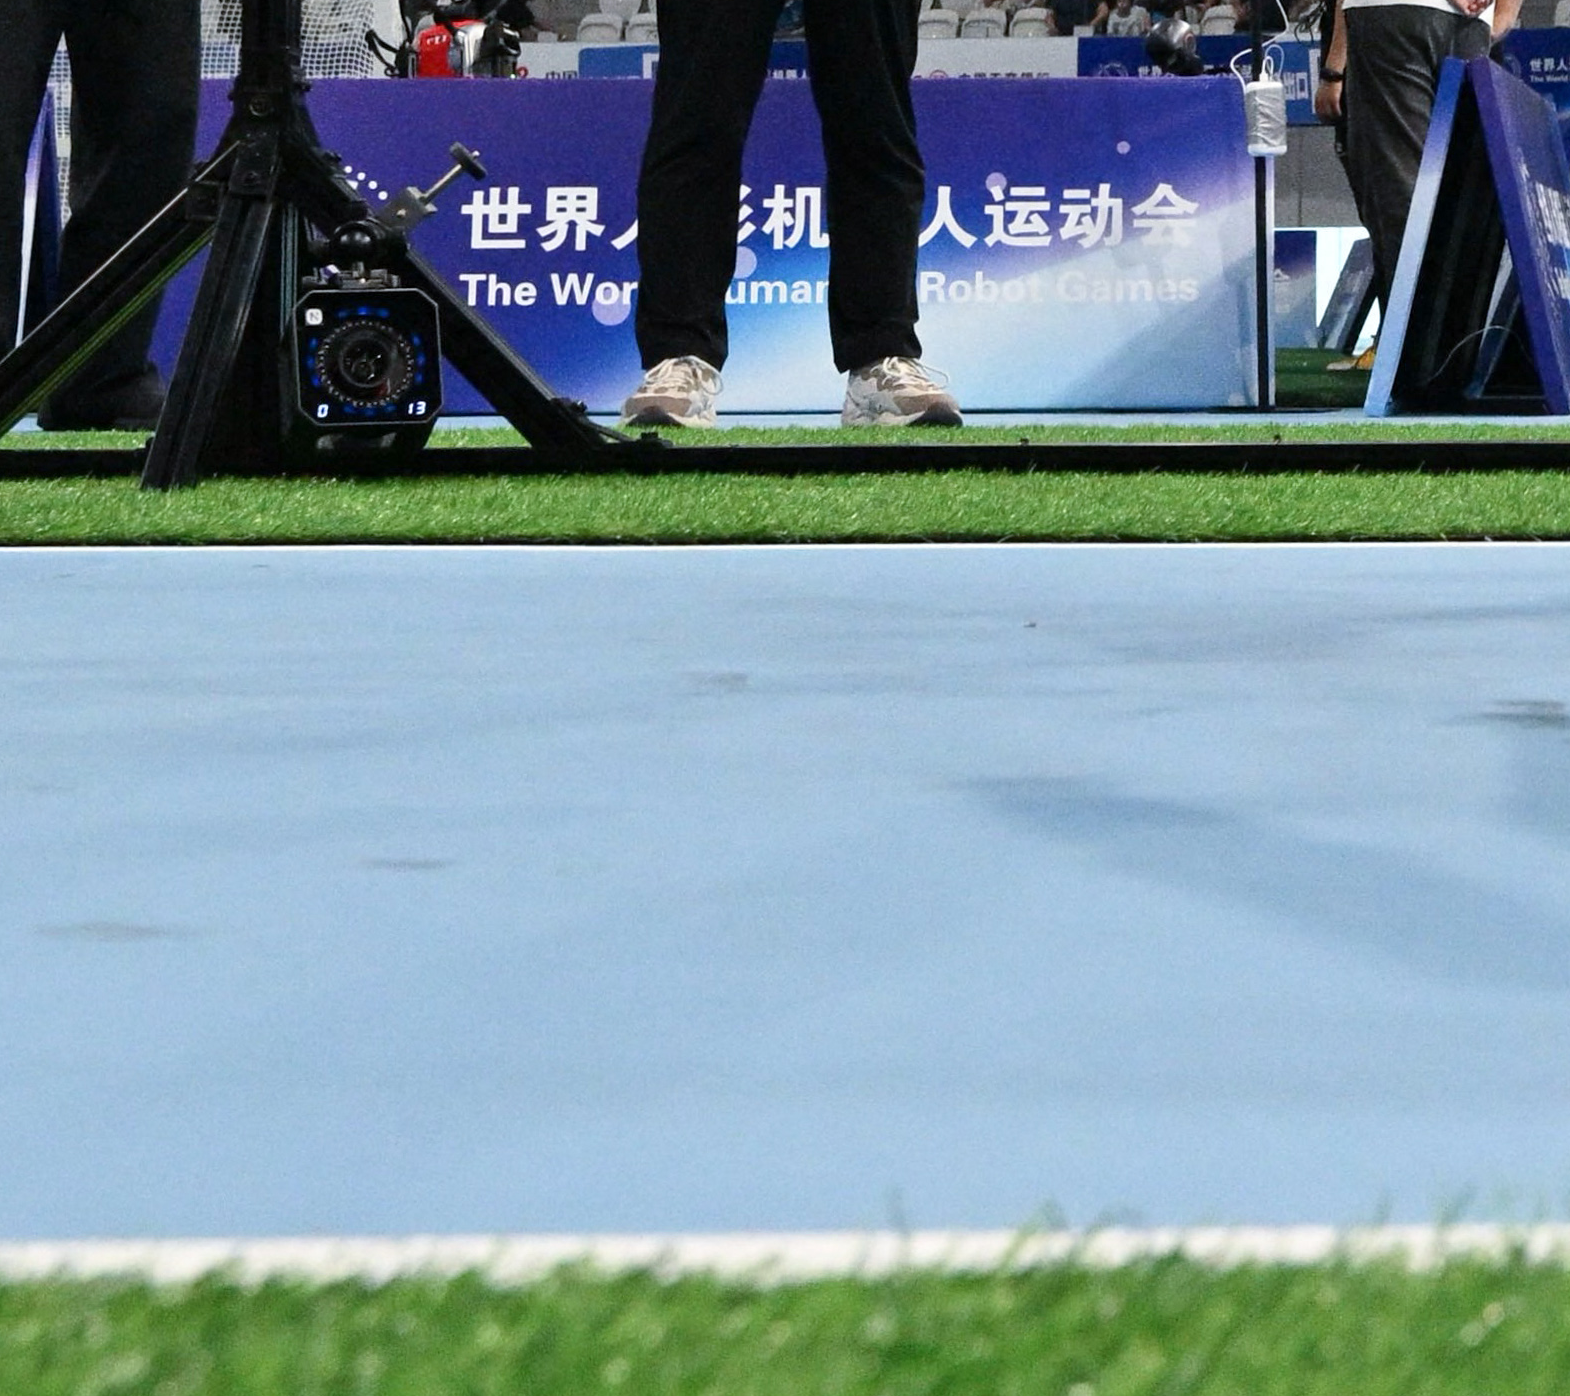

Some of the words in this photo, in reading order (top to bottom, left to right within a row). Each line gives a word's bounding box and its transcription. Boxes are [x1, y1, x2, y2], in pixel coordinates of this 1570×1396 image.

[459, 274, 538, 307] The
[920, 270, 1042, 304] Robot
[407, 401, 427, 415] 13
